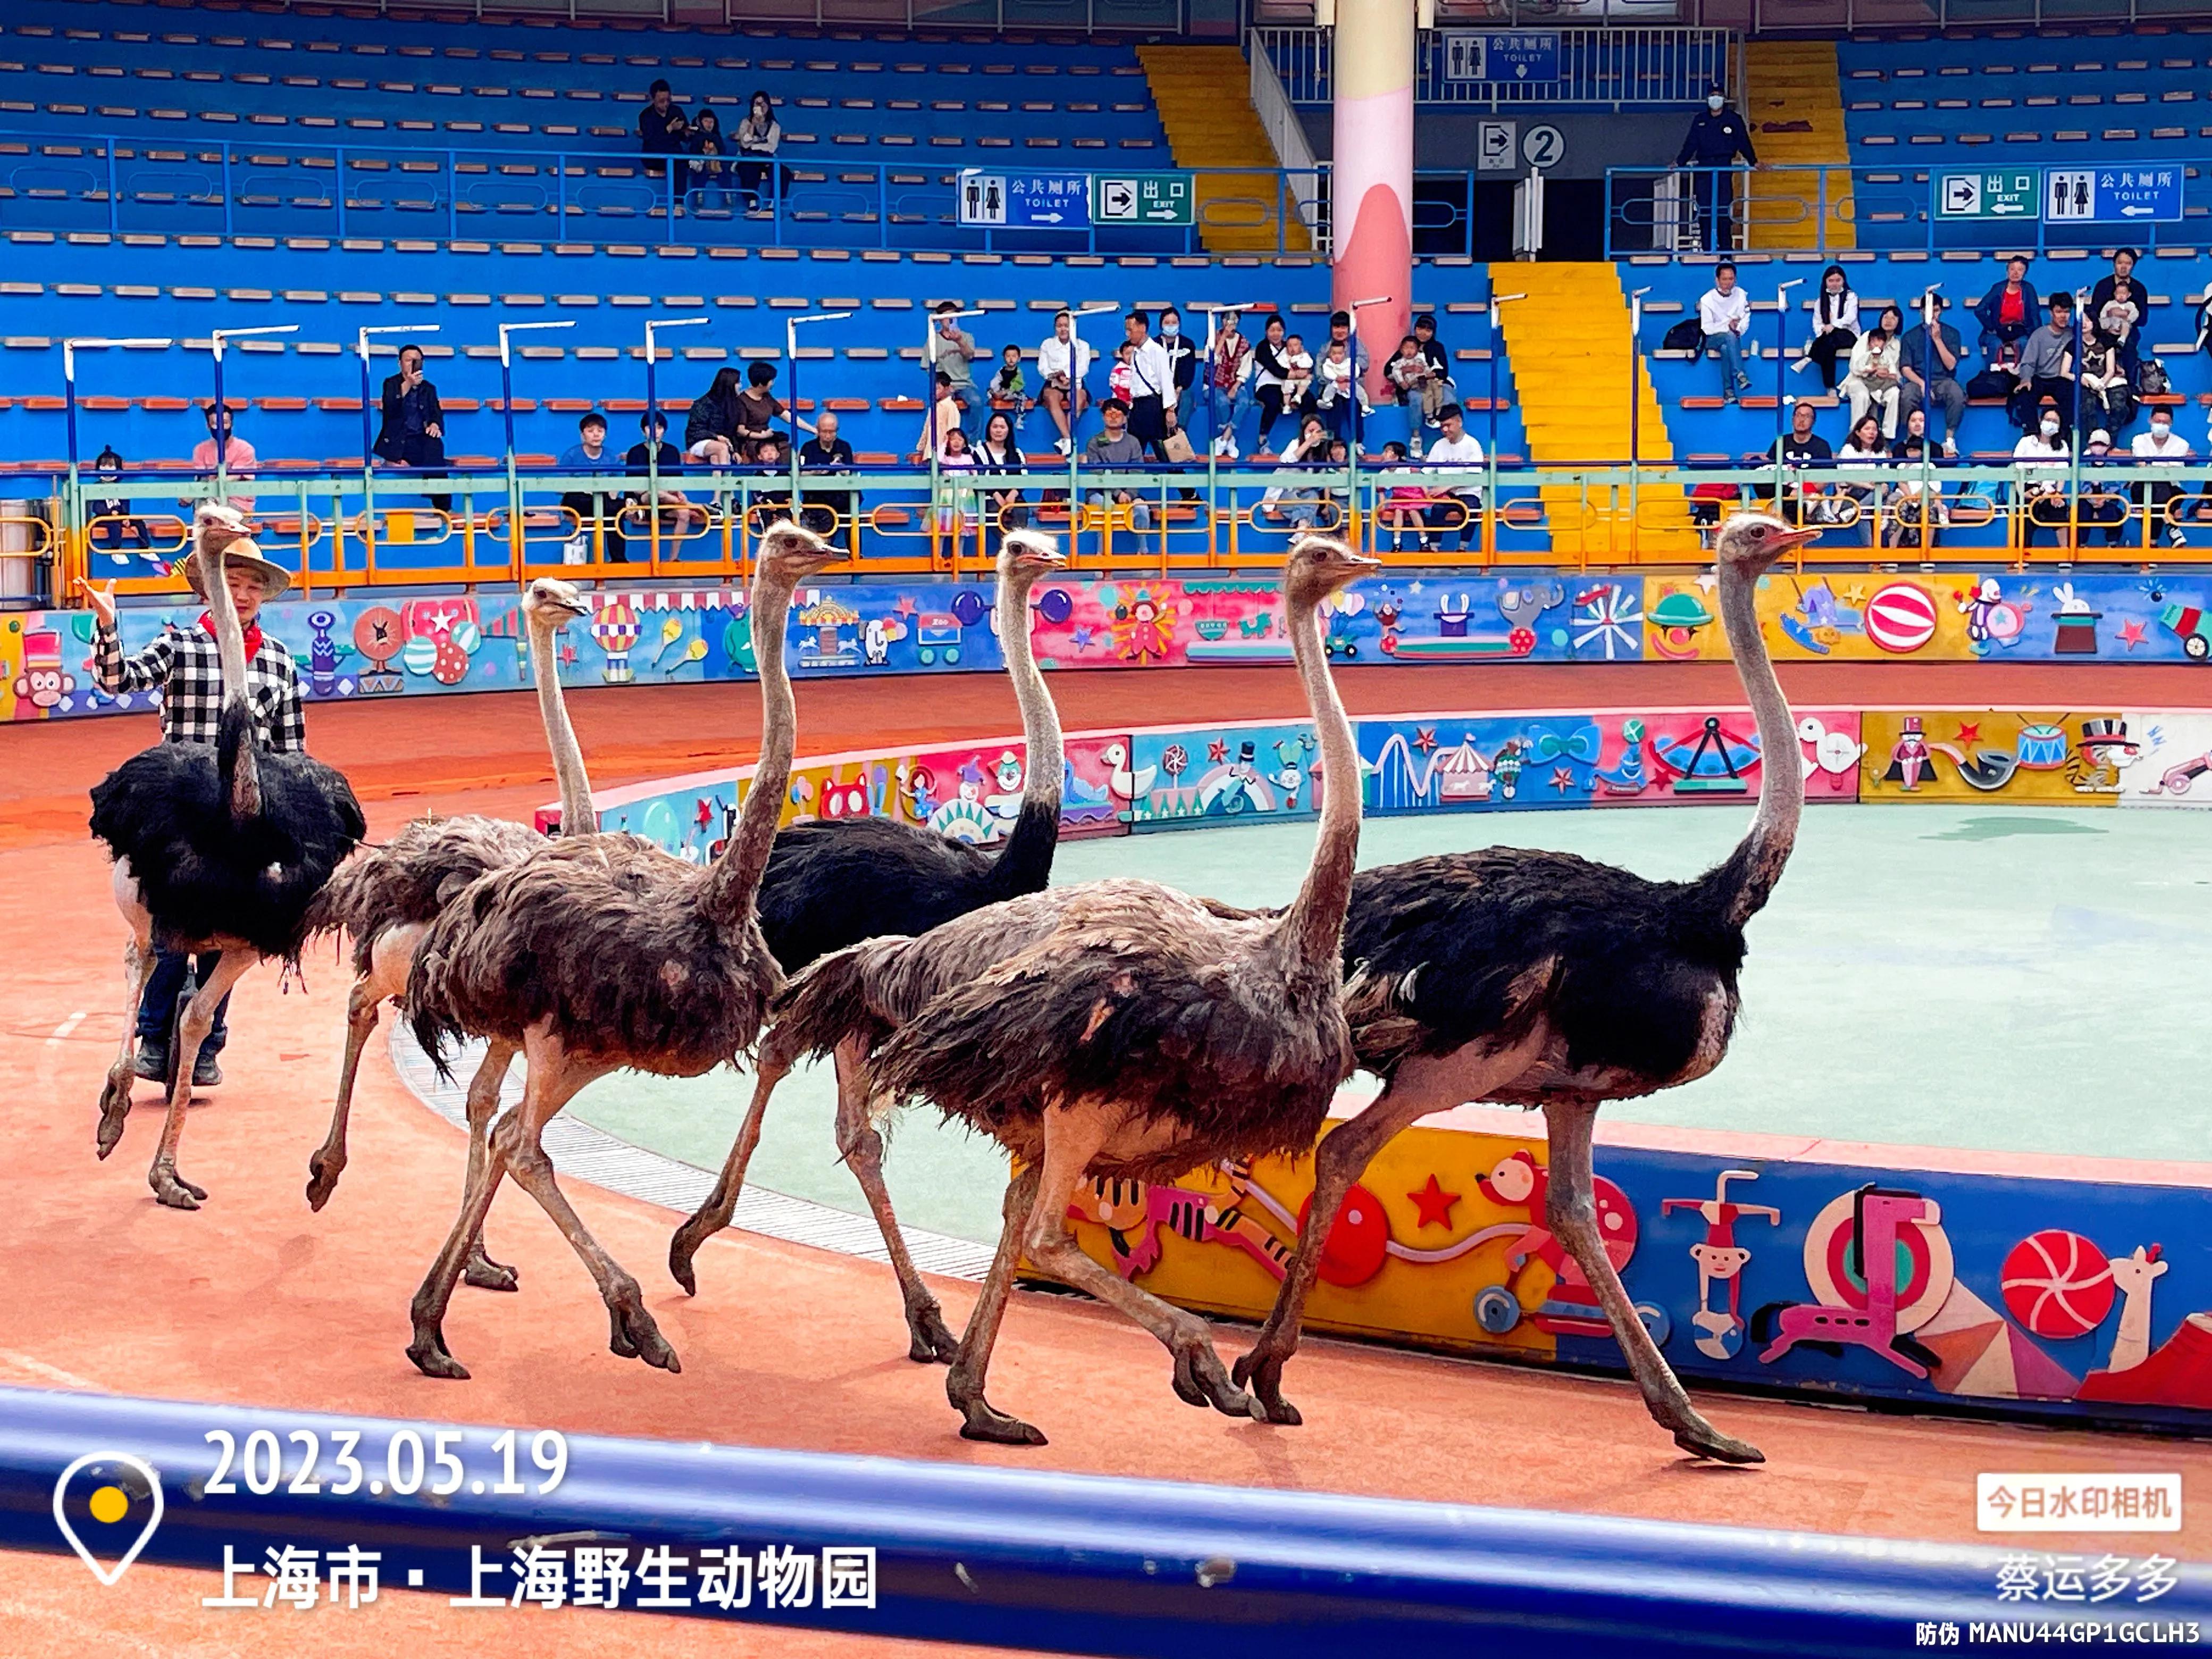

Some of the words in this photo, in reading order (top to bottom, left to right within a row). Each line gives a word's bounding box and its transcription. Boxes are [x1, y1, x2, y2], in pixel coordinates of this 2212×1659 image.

[1493, 37, 1552, 51] 公共厕所
[1504, 54, 1542, 62] TOILET
[1534, 130, 1554, 162] 2
[1987, 174, 2030, 193] 出口
[2101, 171, 2172, 188] 公共厕所
[1012, 179, 1082, 195] 公共厕所
[1143, 180, 1184, 199] 出口
[1997, 194, 2020, 202] EXIT
[2113, 191, 2160, 200] TOILET
[1025, 198, 1069, 208] TOILET
[1153, 200, 1175, 208] EXIT
